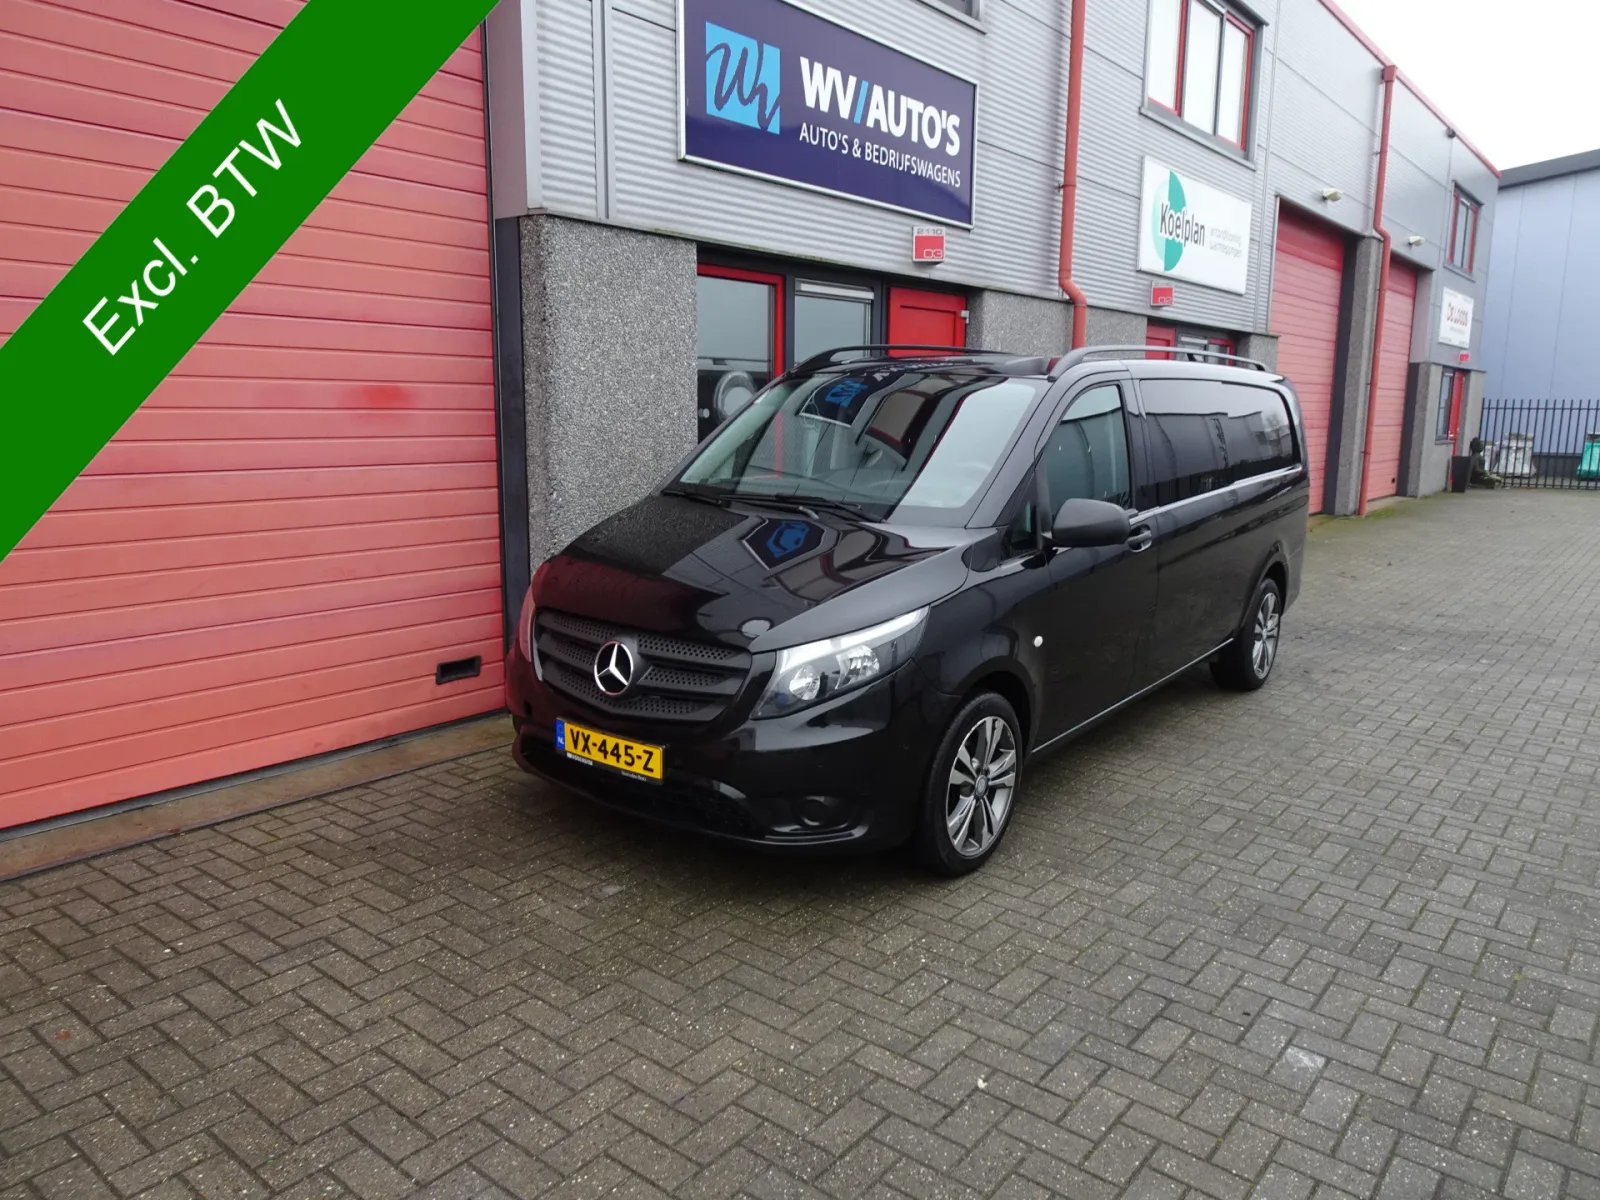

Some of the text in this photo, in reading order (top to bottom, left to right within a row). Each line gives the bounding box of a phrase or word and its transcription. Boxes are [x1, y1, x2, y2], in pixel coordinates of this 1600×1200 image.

[799, 122, 961, 188] AUTO'S & BEDRIJFSWAGENS
[1160, 202, 1205, 248] Koelplan
[557, 736, 565, 745] NL
[570, 728, 654, 773] VX-445-Z
